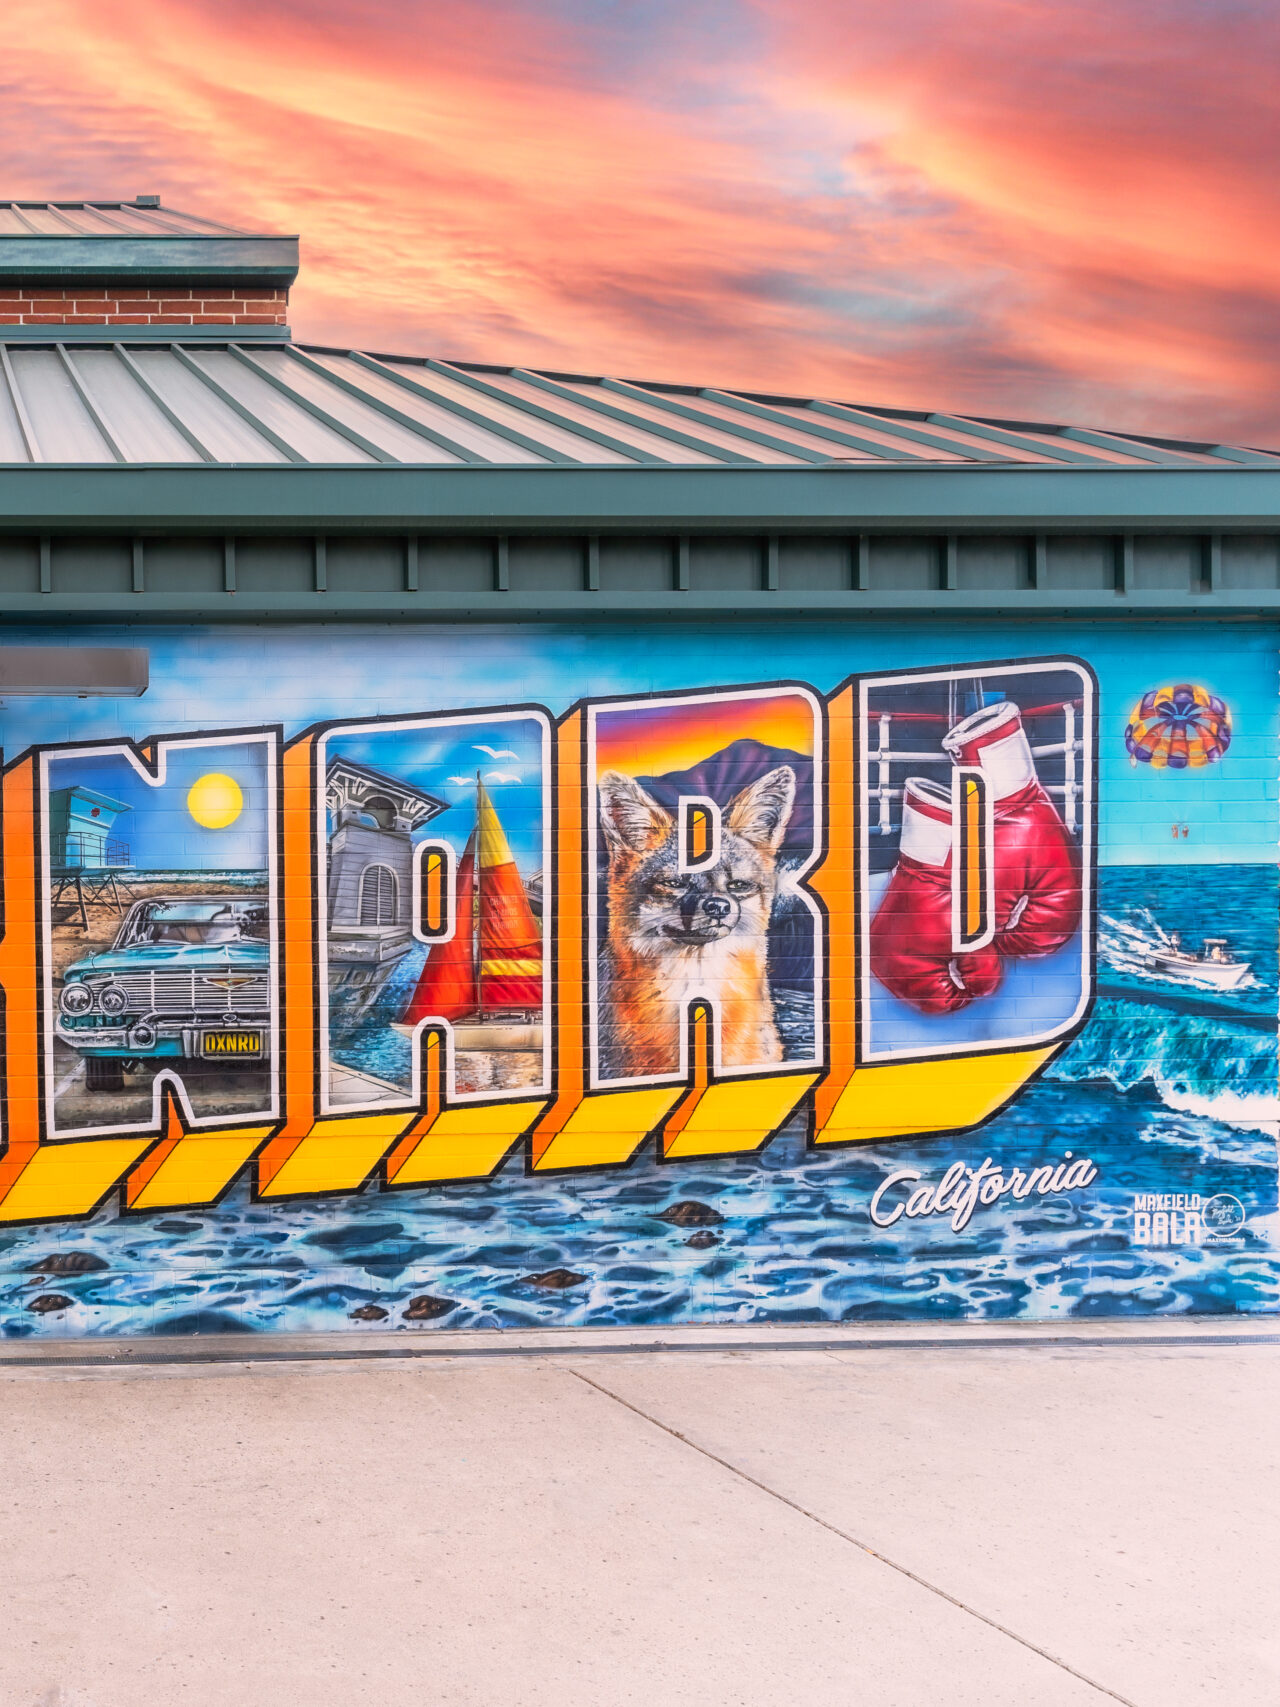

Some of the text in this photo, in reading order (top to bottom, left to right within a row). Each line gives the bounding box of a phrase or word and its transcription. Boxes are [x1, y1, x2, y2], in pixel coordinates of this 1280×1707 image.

[205, 1034, 259, 1052] OXNRD
[870, 1150, 1098, 1233] California
[1134, 1194, 1200, 1211] MAXFIELD
[1134, 1212, 1200, 1244] BALA
